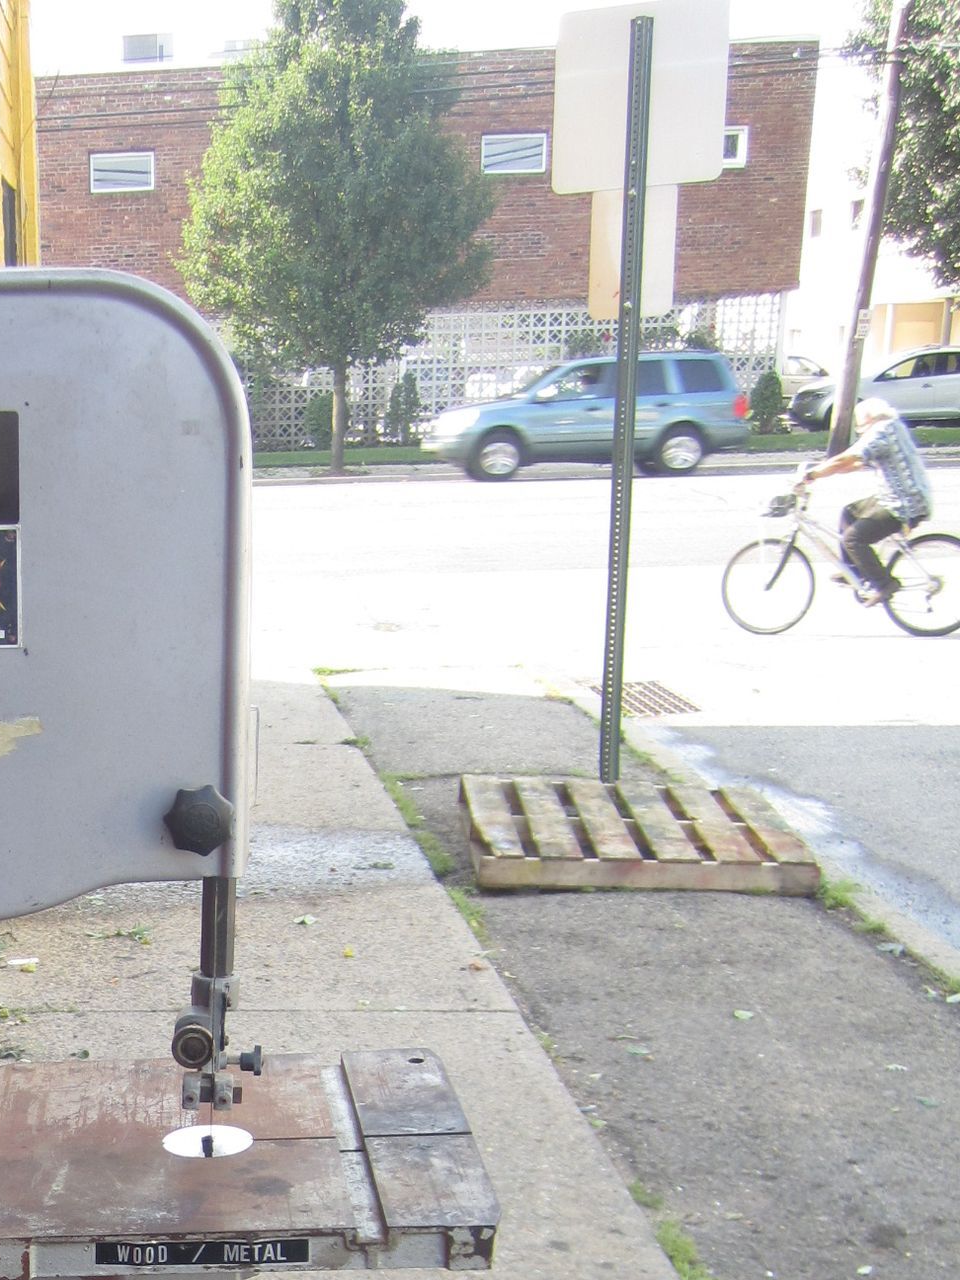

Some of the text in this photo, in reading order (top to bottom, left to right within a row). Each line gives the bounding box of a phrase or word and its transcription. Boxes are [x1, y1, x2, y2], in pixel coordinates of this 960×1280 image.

[117, 1242, 288, 1264] WOOD / METAL
